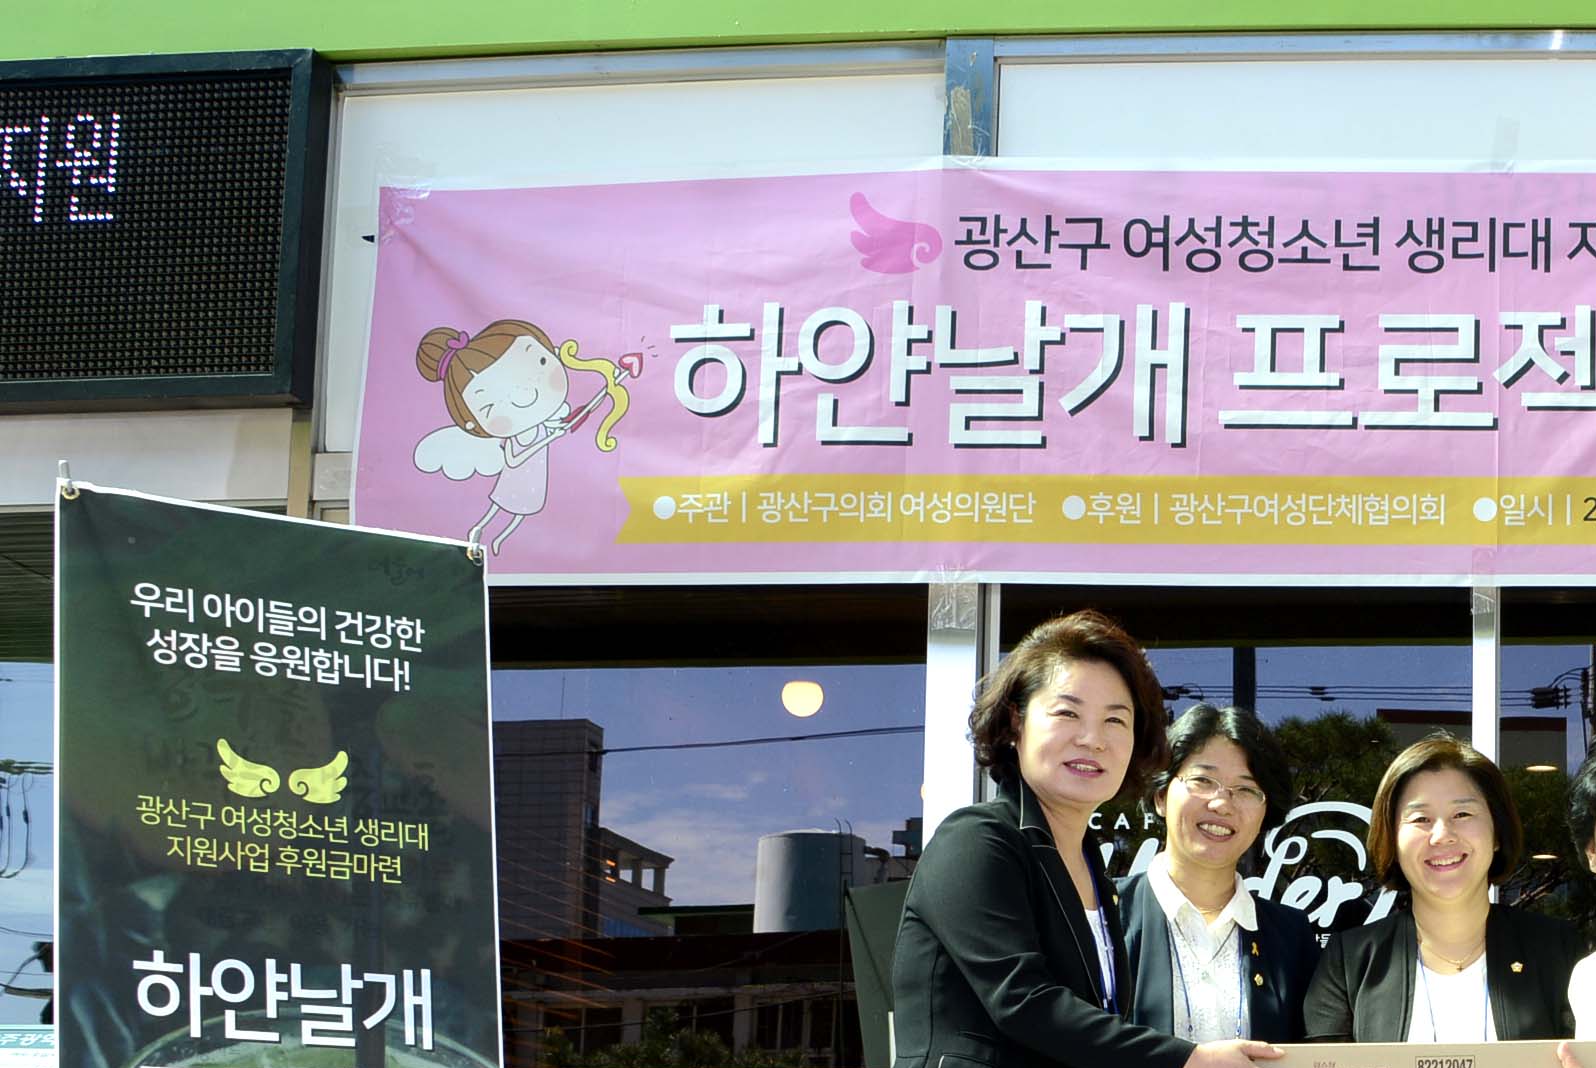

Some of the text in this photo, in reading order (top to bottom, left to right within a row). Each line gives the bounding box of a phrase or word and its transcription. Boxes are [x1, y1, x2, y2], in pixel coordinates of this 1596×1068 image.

[953, 215, 1110, 271] 광산구
[1123, 215, 1381, 274] 여성청소년
[1396, 216, 1552, 274] 생리대
[669, 299, 1191, 449] 하얀날개
[677, 491, 732, 524] 주관
[756, 492, 893, 526] 광산구의회
[899, 491, 1036, 526] 여성의원단
[1087, 491, 1142, 526] 후원
[1170, 492, 1446, 527] 광산구여성단체협의회
[1499, 494, 1554, 527] 일시
[129, 581, 426, 654] 우리 아이들의 건강한
[145, 628, 412, 693] 성장을 응원합니다!
[135, 793, 431, 852] 광산구 여성청소년 생리대
[166, 835, 403, 885] 지원사업 후원금마련
[131, 949, 436, 1051] 하얀날개
